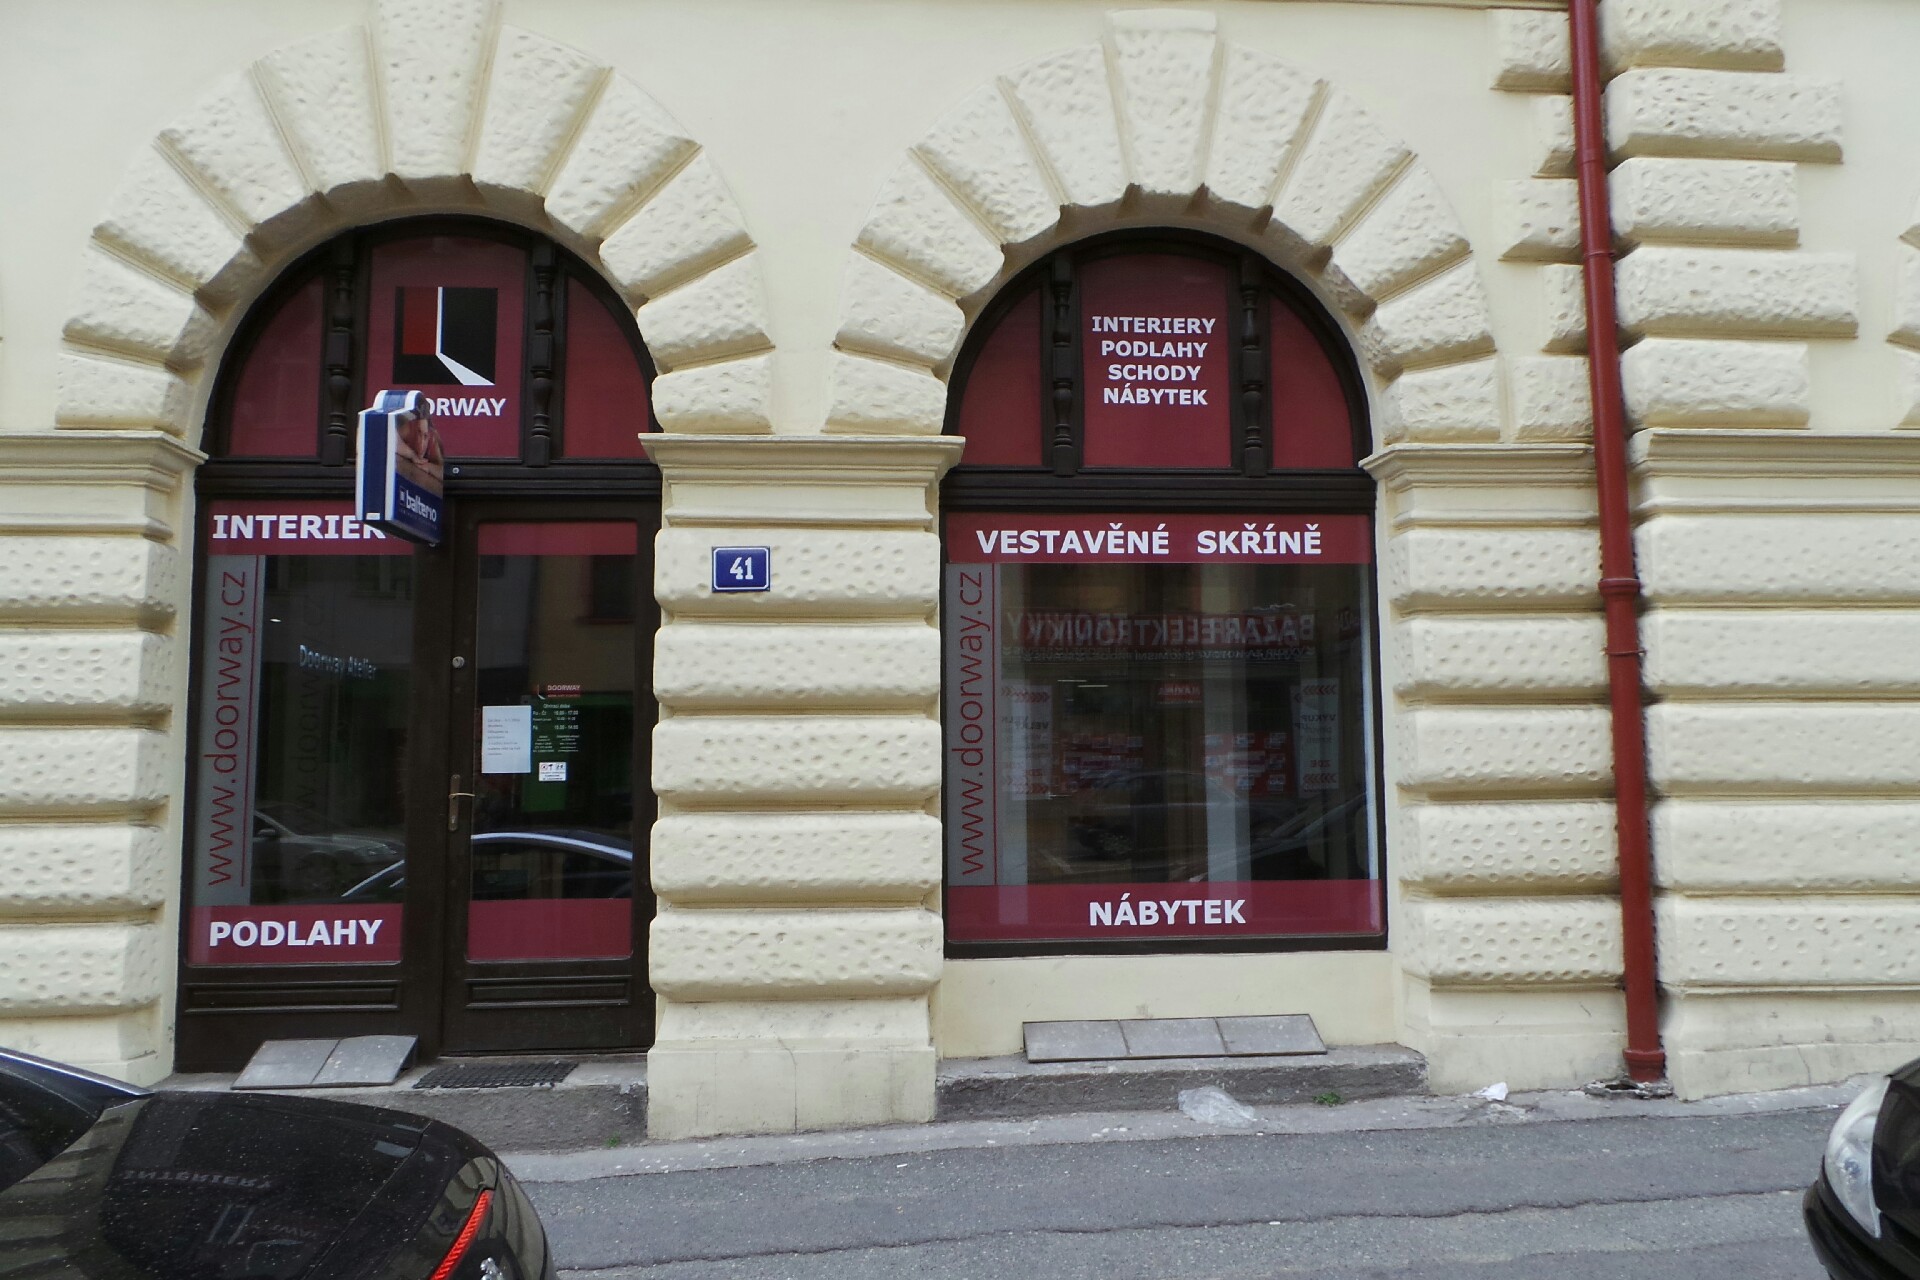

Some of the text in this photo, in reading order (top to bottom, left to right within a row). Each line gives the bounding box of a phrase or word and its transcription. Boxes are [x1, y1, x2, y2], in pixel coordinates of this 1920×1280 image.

[1091, 315, 1217, 335] INTERIERY
[1101, 340, 1208, 359] PODLAHY
[1107, 364, 1202, 382] SCHODY
[1103, 383, 1209, 406] NÁBYTEK
[212, 514, 387, 540] INTERIER
[976, 522, 1323, 555] VESTAVĚNÉ SKŘÍNĚ
[729, 556, 754, 580] 41
[203, 570, 255, 888] www.doorway.cz
[951, 571, 991, 876] www.doorway.cz
[1088, 893, 1246, 927] NÁBYTEK
[208, 919, 384, 948] PODLAHY
